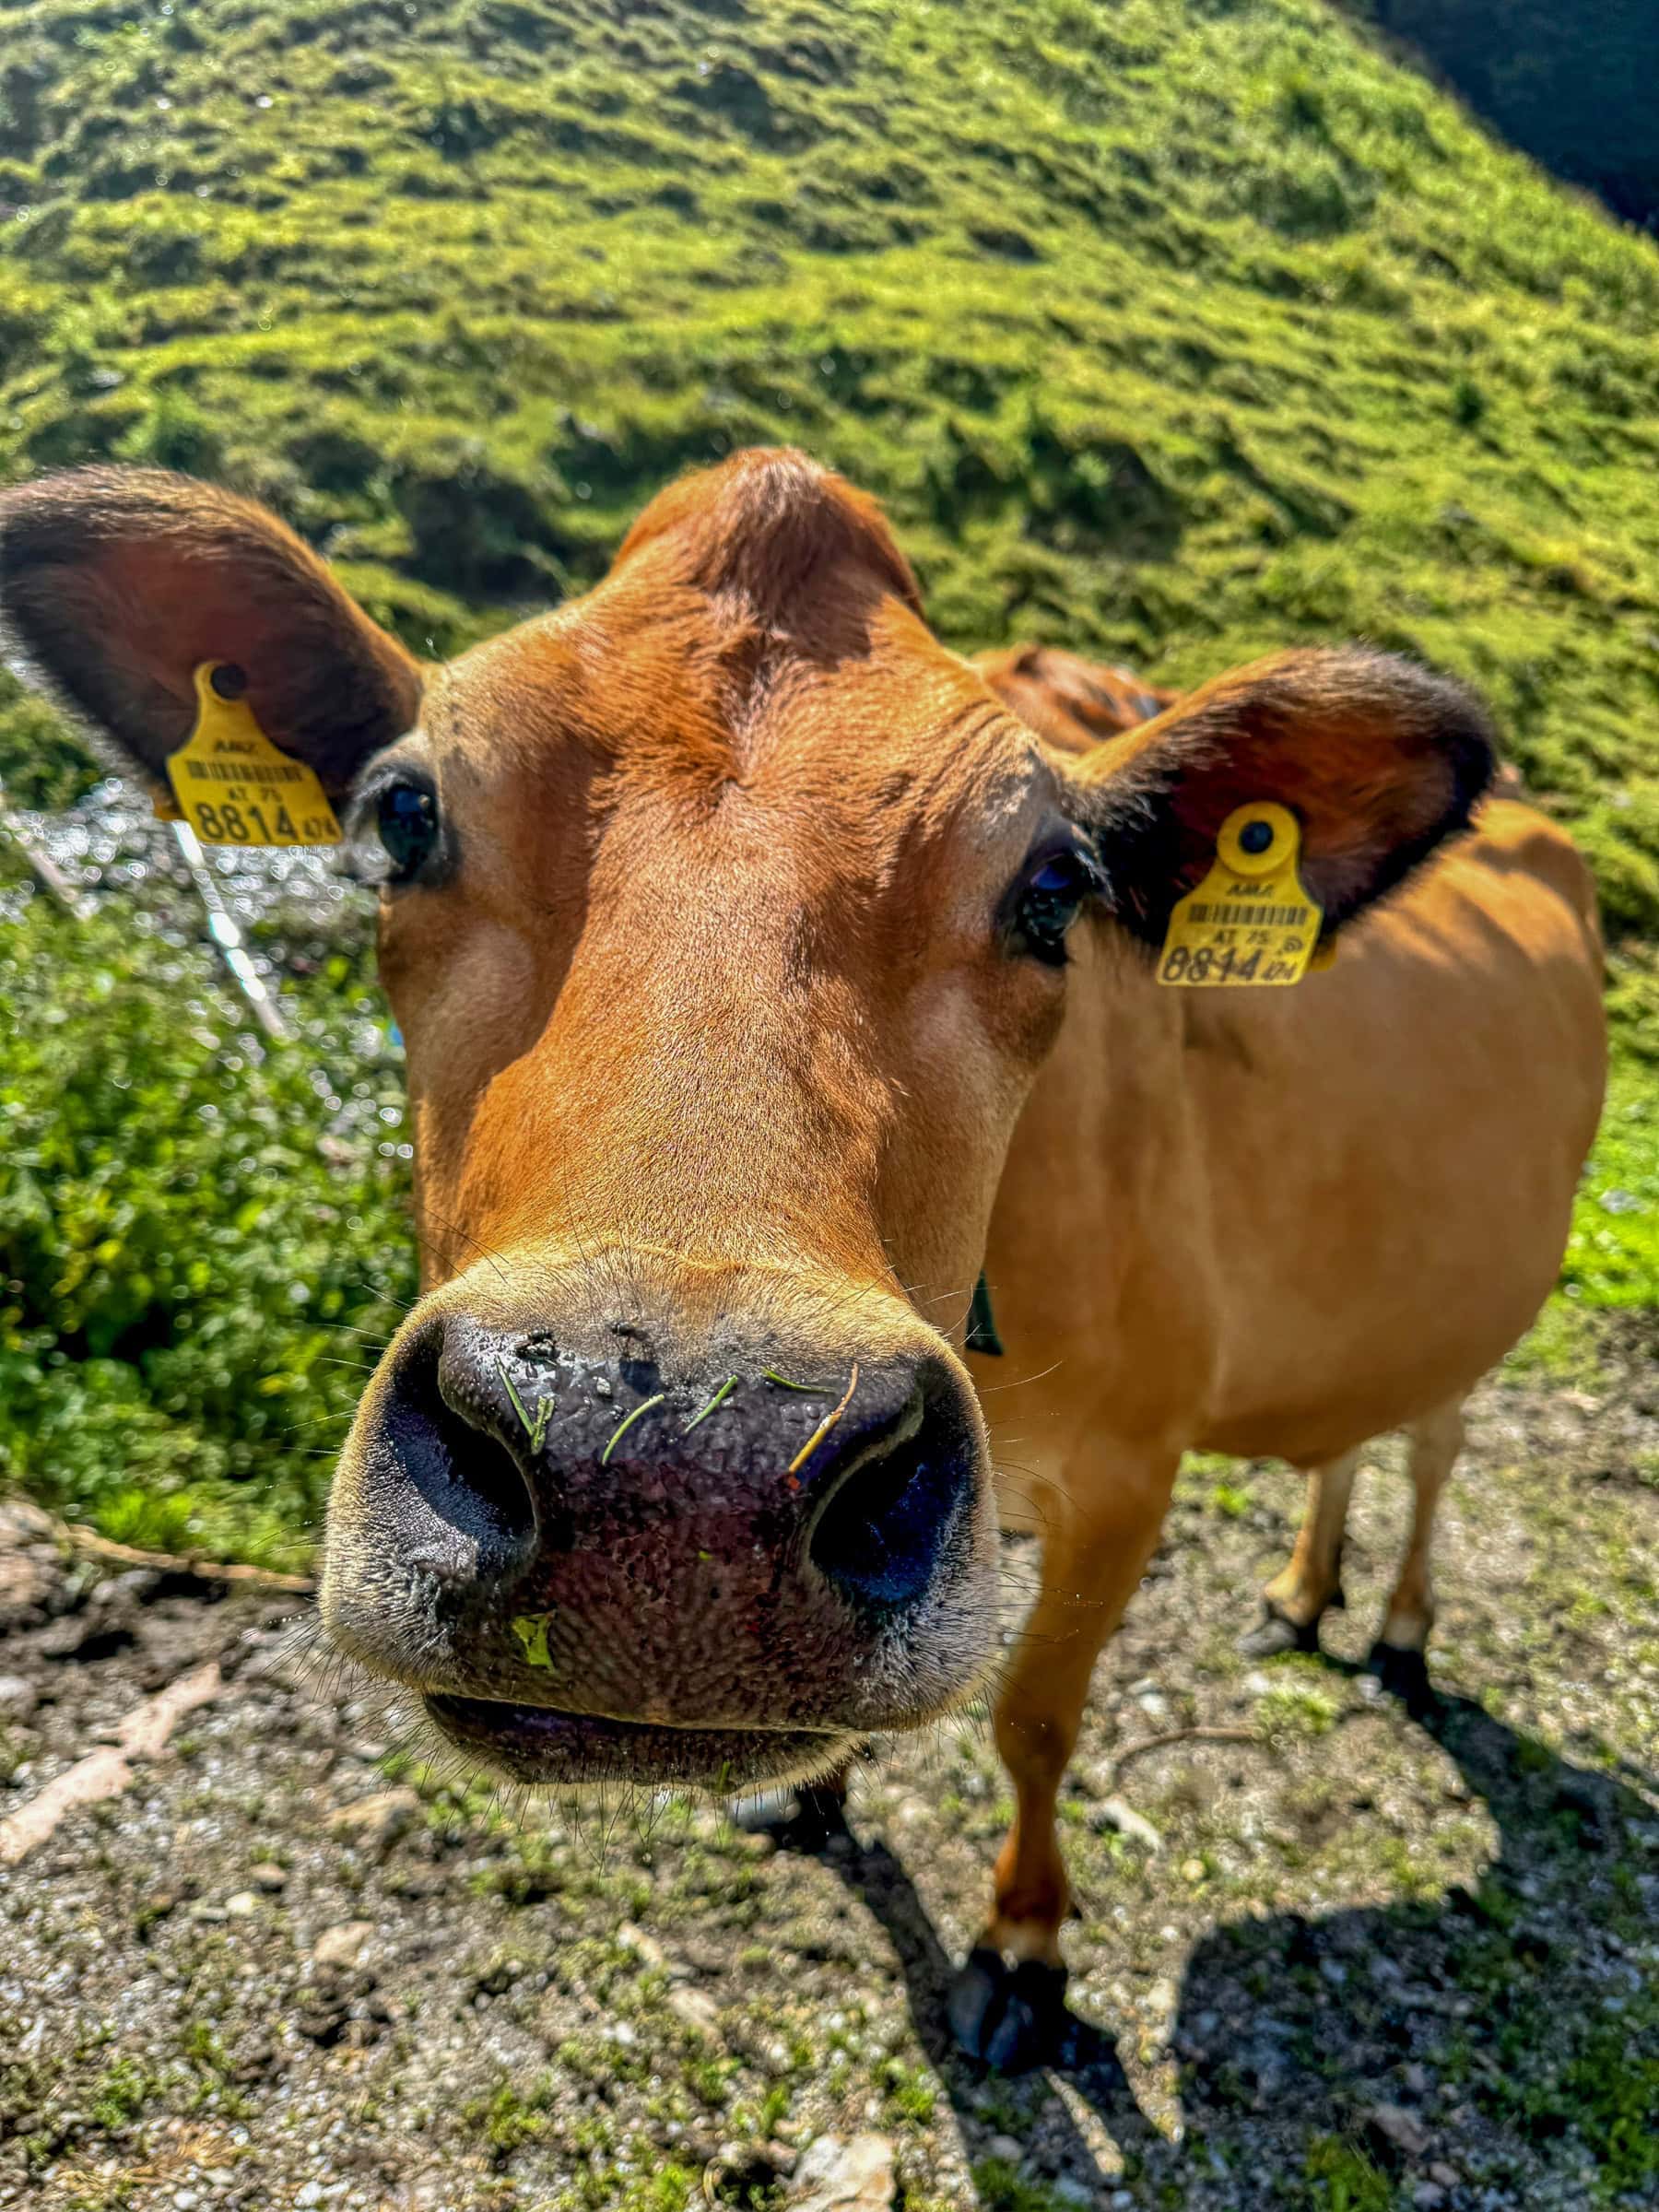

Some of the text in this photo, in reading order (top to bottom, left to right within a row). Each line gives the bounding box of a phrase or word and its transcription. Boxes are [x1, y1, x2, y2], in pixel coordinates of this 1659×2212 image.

[195, 801, 300, 842] 8814
[1213, 929, 1237, 945] AT
[1162, 946, 1264, 983] 8814
